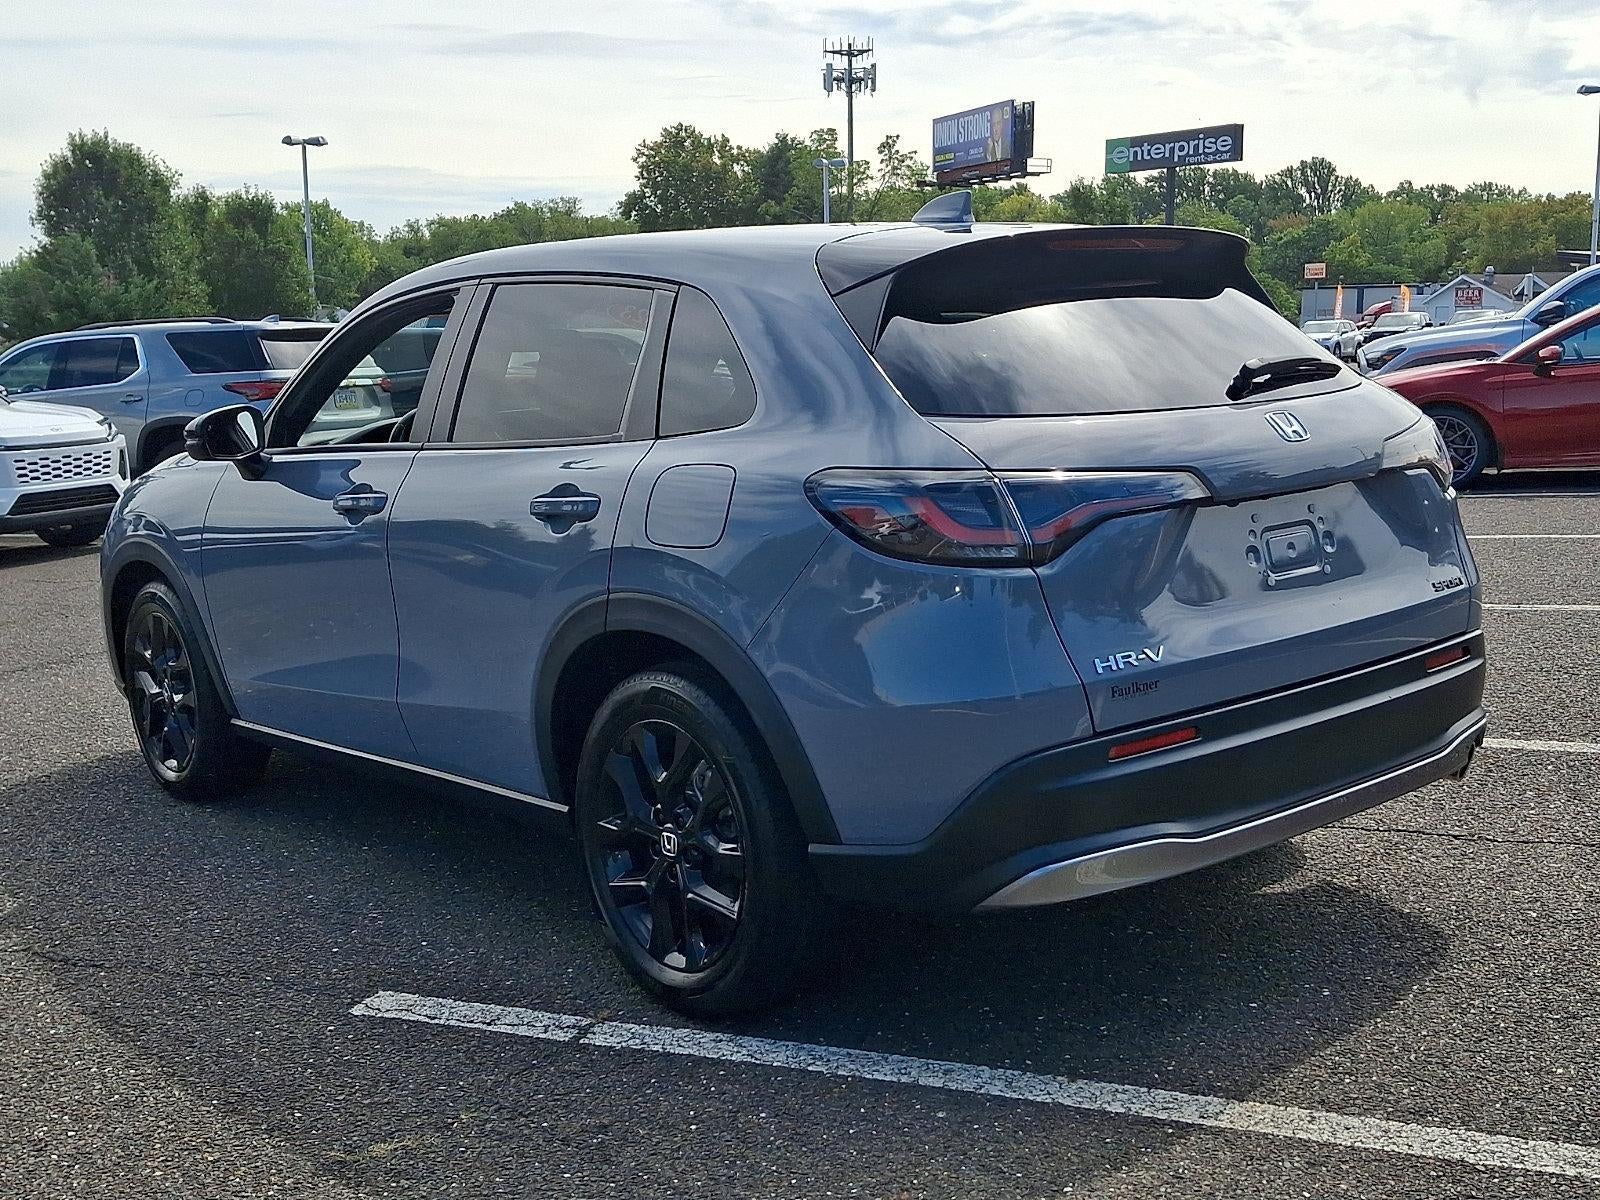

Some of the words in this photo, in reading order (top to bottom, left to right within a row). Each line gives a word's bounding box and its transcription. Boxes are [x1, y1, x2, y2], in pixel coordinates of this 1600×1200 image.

[934, 120, 958, 148] UNION
[959, 111, 991, 143] STRONG
[1112, 133, 1233, 164] enterprise
[1185, 152, 1231, 164] rent-a-car
[1457, 289, 1480, 297] BEER
[1094, 645, 1164, 674] HR-V
[1110, 679, 1160, 698] Faulkner
